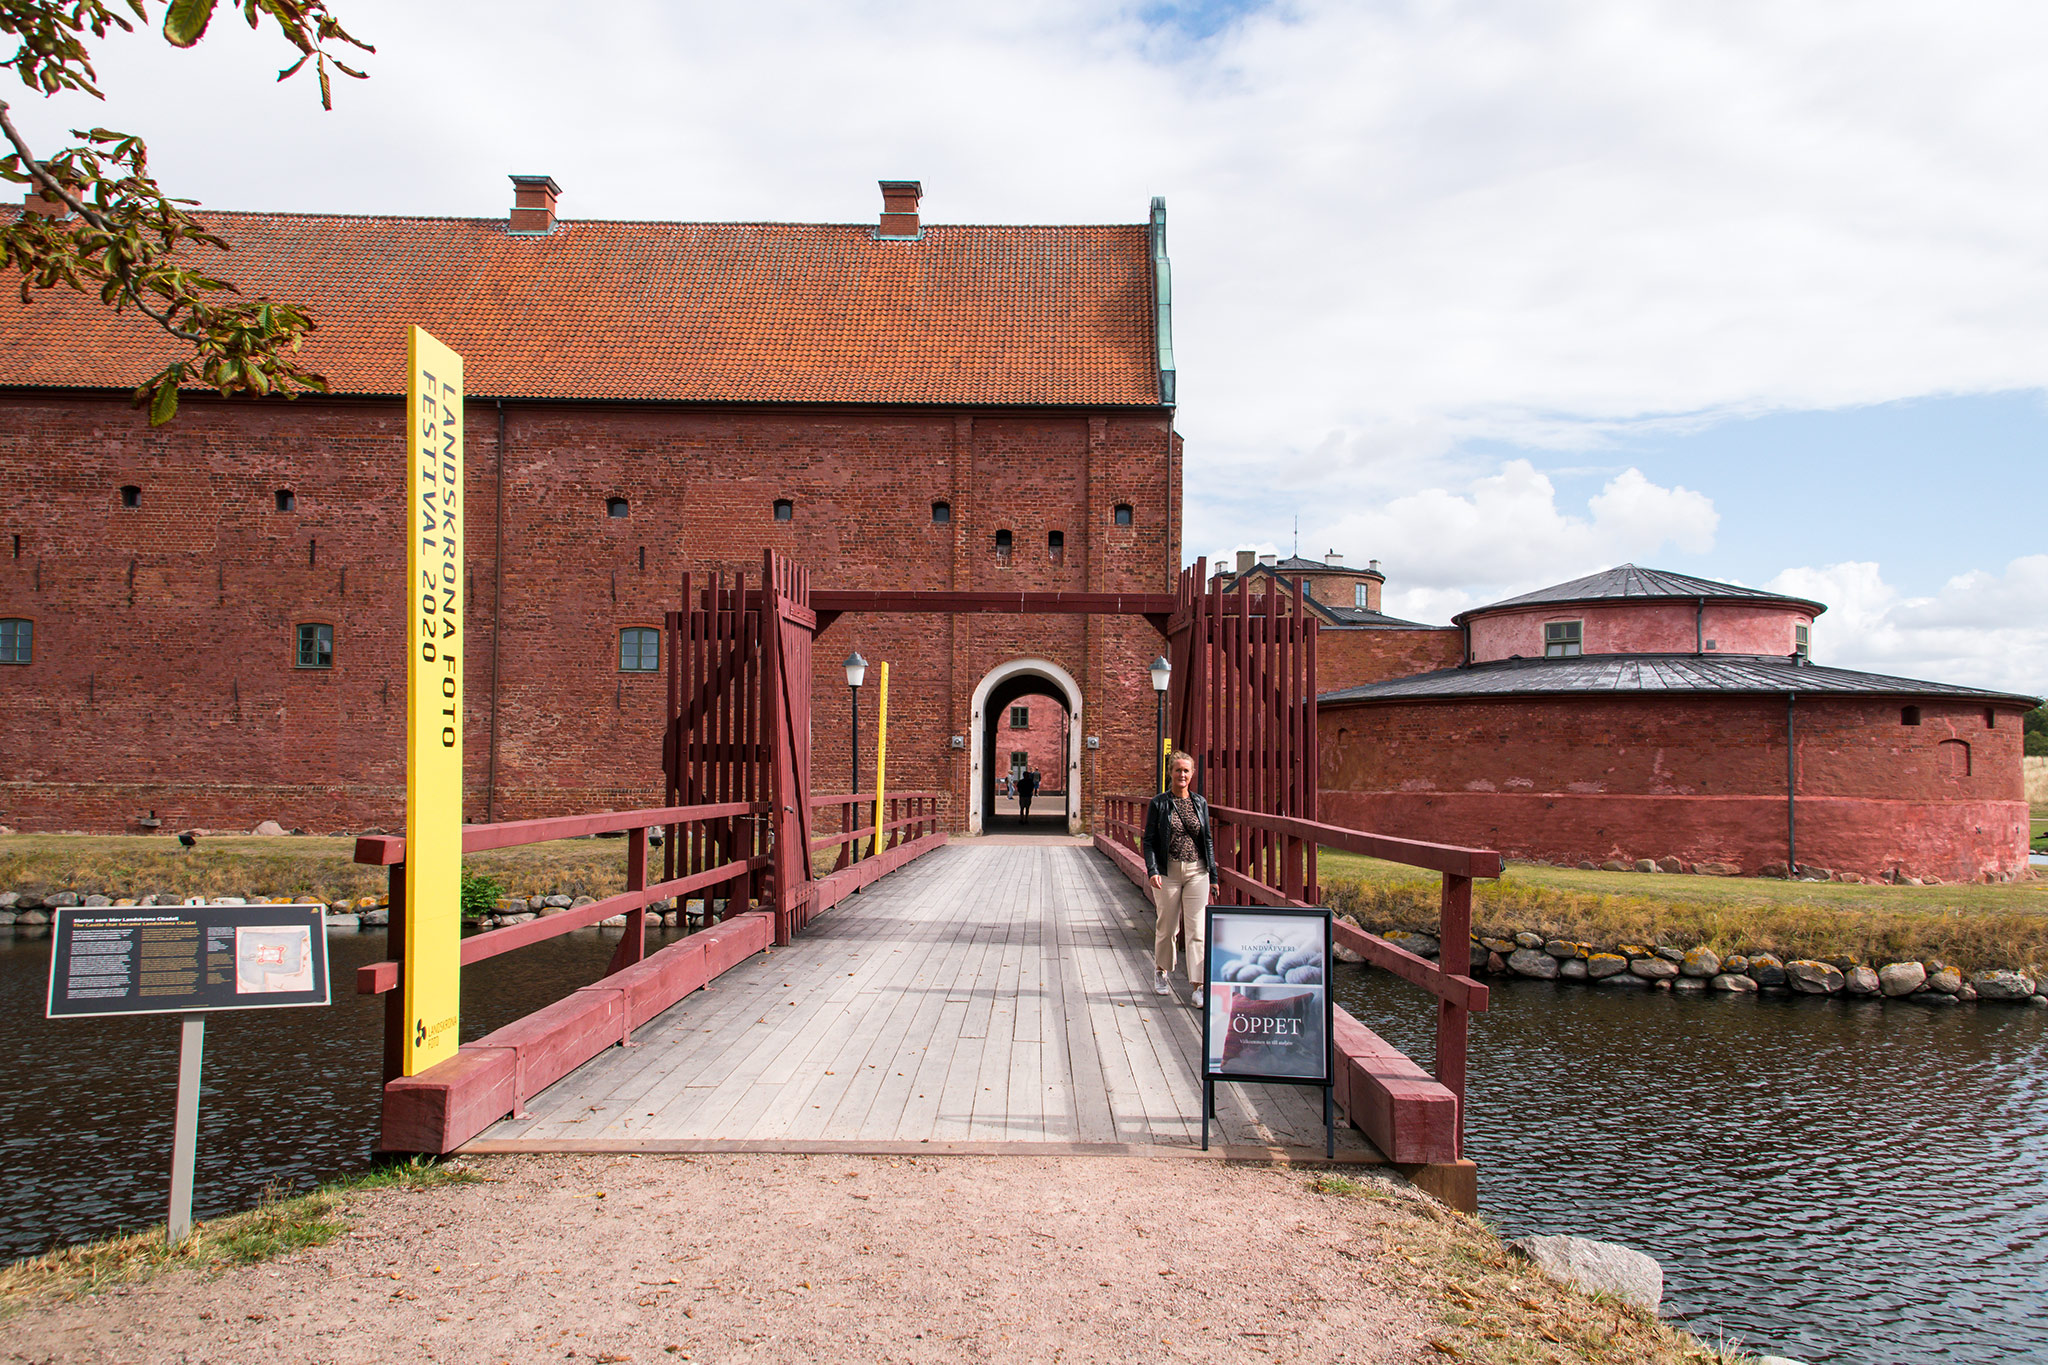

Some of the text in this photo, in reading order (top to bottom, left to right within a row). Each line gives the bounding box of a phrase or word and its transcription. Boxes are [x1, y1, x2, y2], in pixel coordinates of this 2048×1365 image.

[422, 370, 437, 663] FESTIVAL 2020
[442, 383, 456, 748] LANDSKRONA FOTO
[1232, 1013, 1302, 1035] ÖPPET
